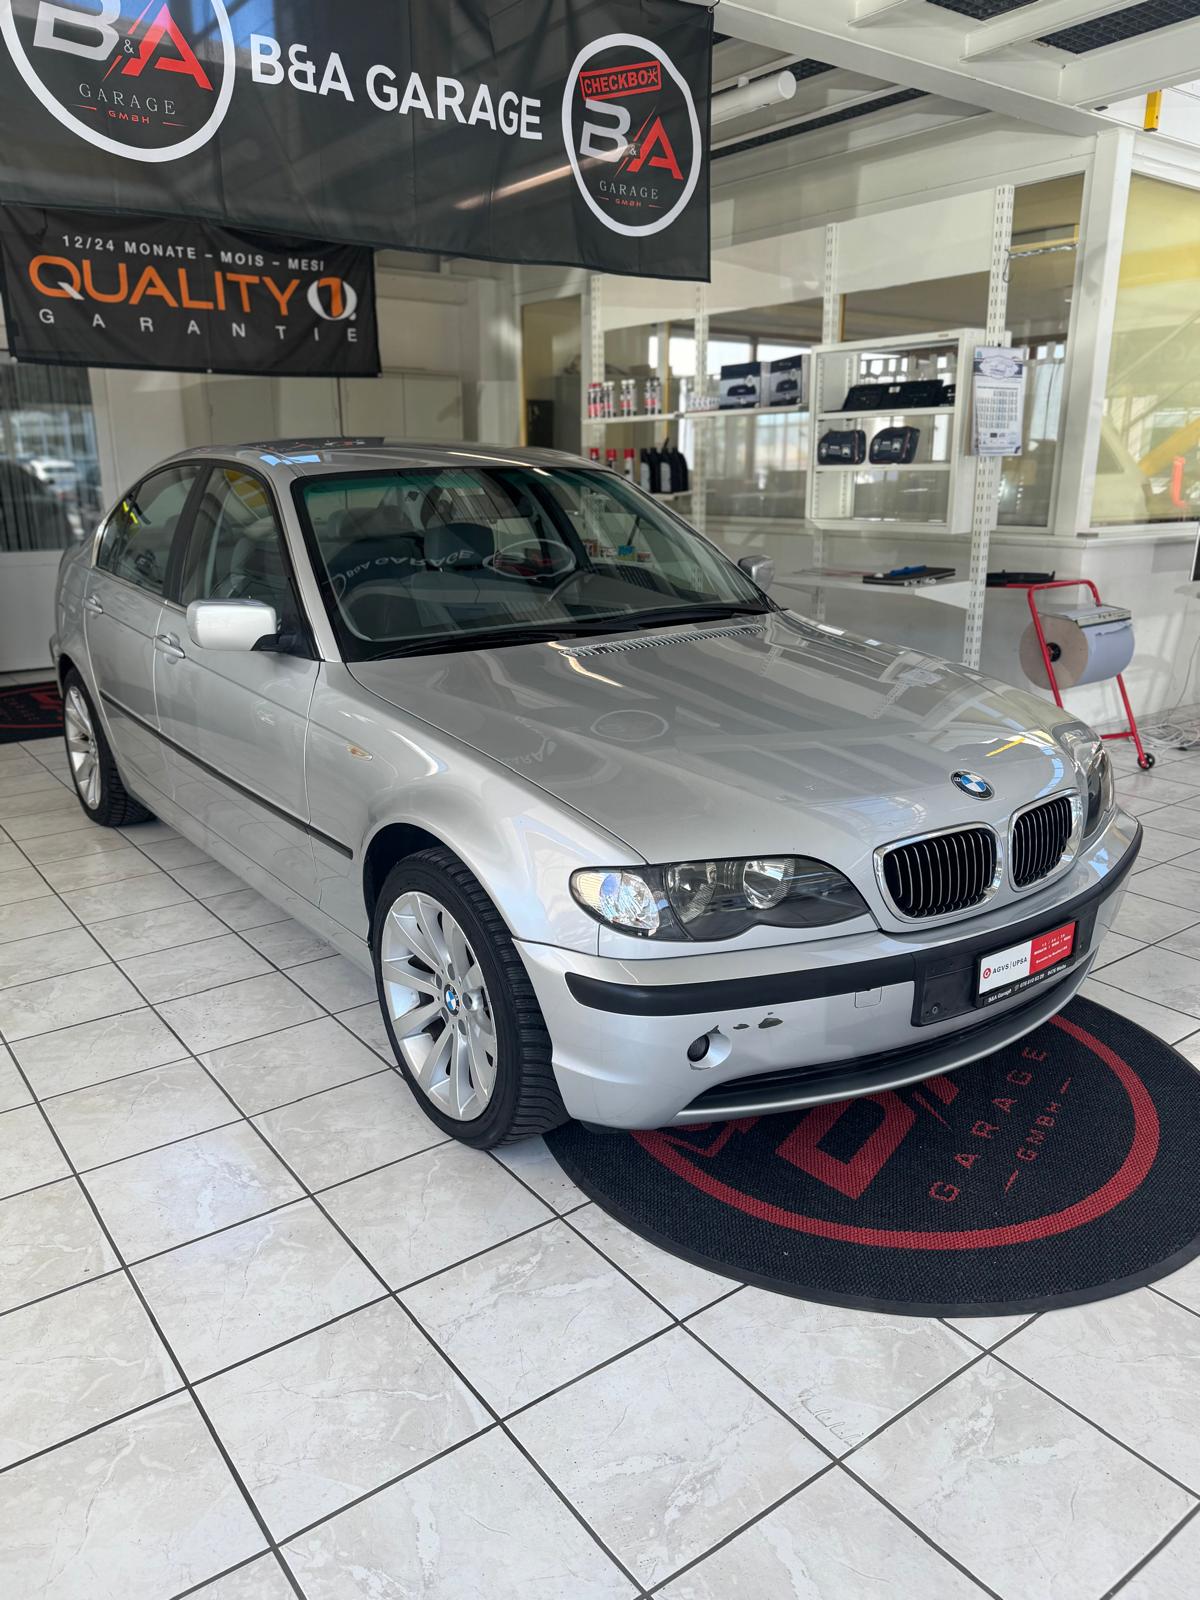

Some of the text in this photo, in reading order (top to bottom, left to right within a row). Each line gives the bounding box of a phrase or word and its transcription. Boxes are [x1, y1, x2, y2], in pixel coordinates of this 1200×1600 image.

[250, 33, 543, 141] B&A GARAGE
[584, 68, 659, 94] CHECKBOX
[79, 83, 176, 115] GARAGE
[108, 110, 150, 125] GMBH
[600, 180, 659, 200] GARAGE
[62, 235, 115, 251] 12/24
[124, 240, 197, 260] MONATE
[220, 251, 264, 267] MOIS
[288, 258, 325, 272] MESI
[28, 254, 300, 317] QUALITY
[39, 308, 358, 342] GARANTIE
[992, 956, 1028, 975] AGVS UPSA
[929, 1046, 1047, 1203] GARAGE
